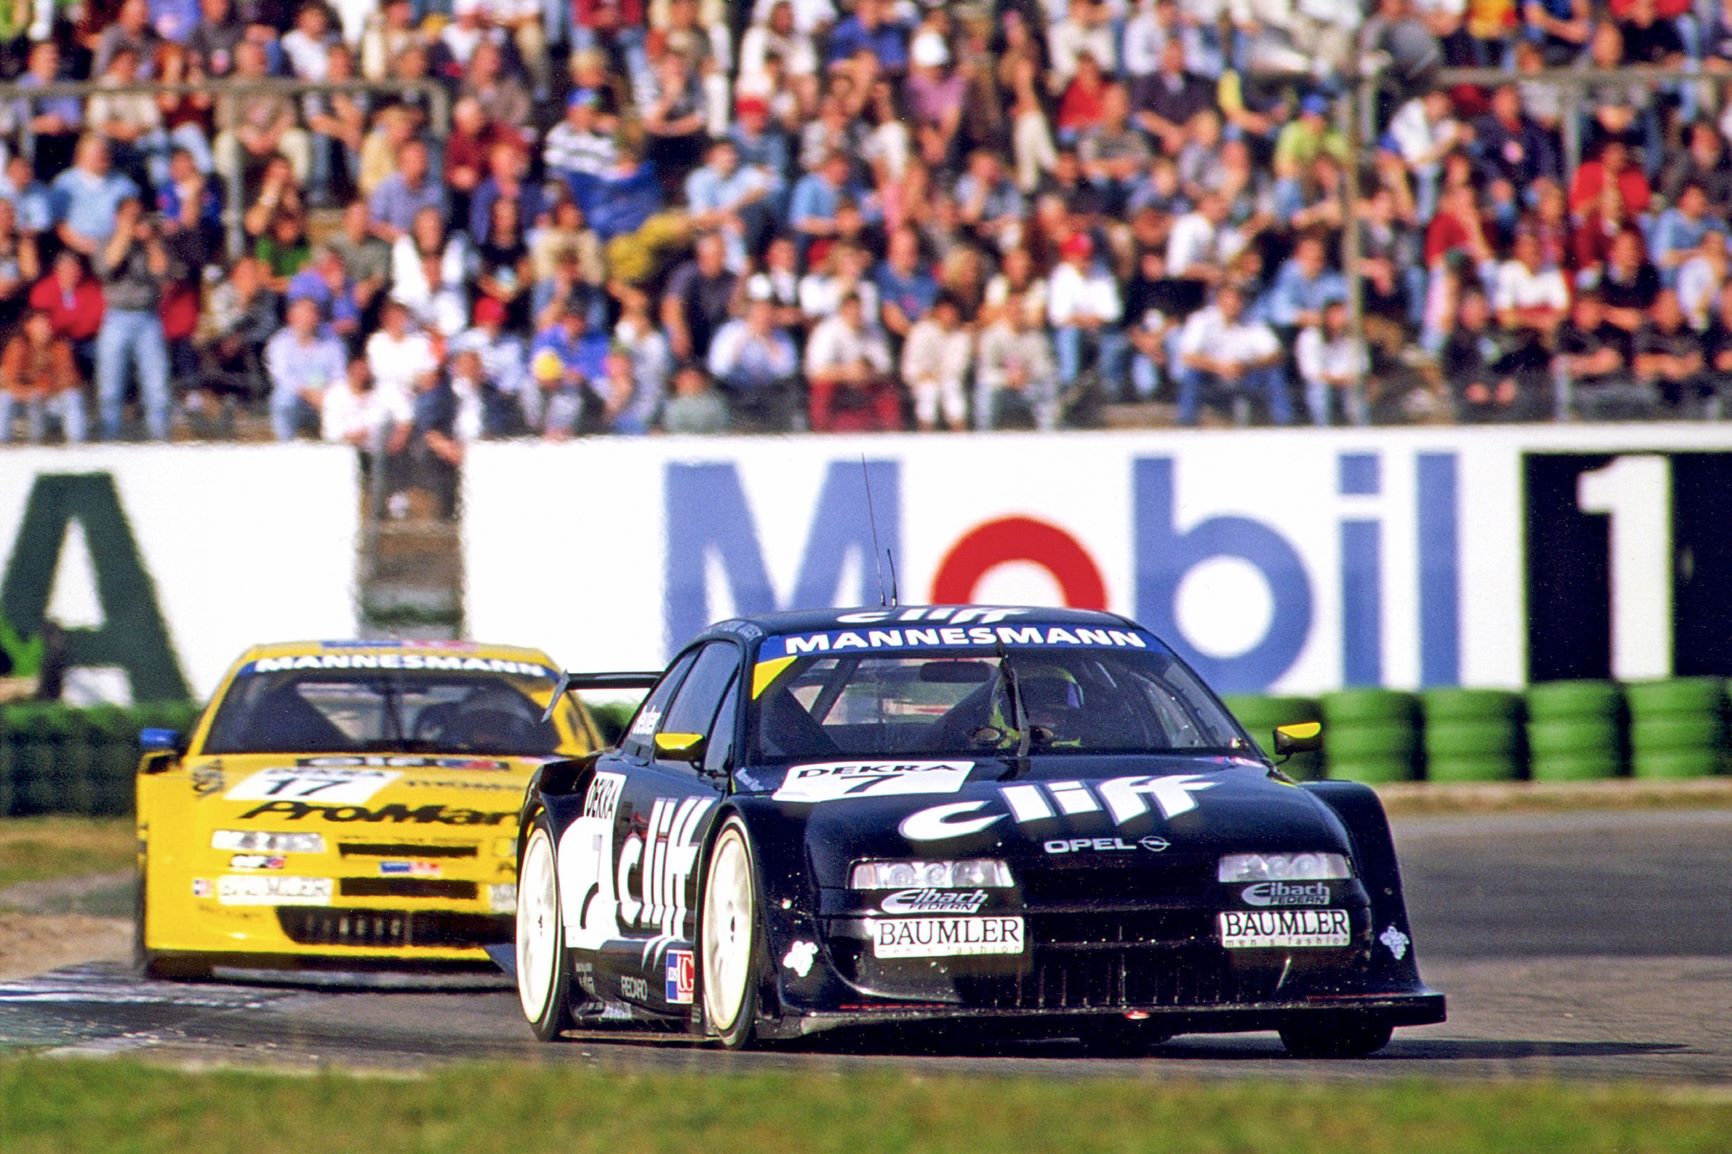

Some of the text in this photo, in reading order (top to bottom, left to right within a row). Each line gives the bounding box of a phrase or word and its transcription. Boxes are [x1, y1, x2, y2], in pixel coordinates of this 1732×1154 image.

[663, 451, 1671, 692] Mobil 1
[836, 608, 1032, 624] cliff
[785, 627, 1146, 653] MANNESMANN
[255, 655, 547, 677] MANNESMANN
[797, 763, 959, 779] DEKRA
[265, 778, 353, 797] 17
[841, 773, 904, 795] 7
[899, 774, 1222, 841] cliff
[1044, 839, 1136, 854] OPEL
[617, 796, 718, 970] cliff
[1241, 882, 1331, 906] Eibach
[881, 888, 989, 913] Eibach
[879, 919, 1019, 946] BÄUMLER
[1225, 911, 1348, 937] BÄUMLER
